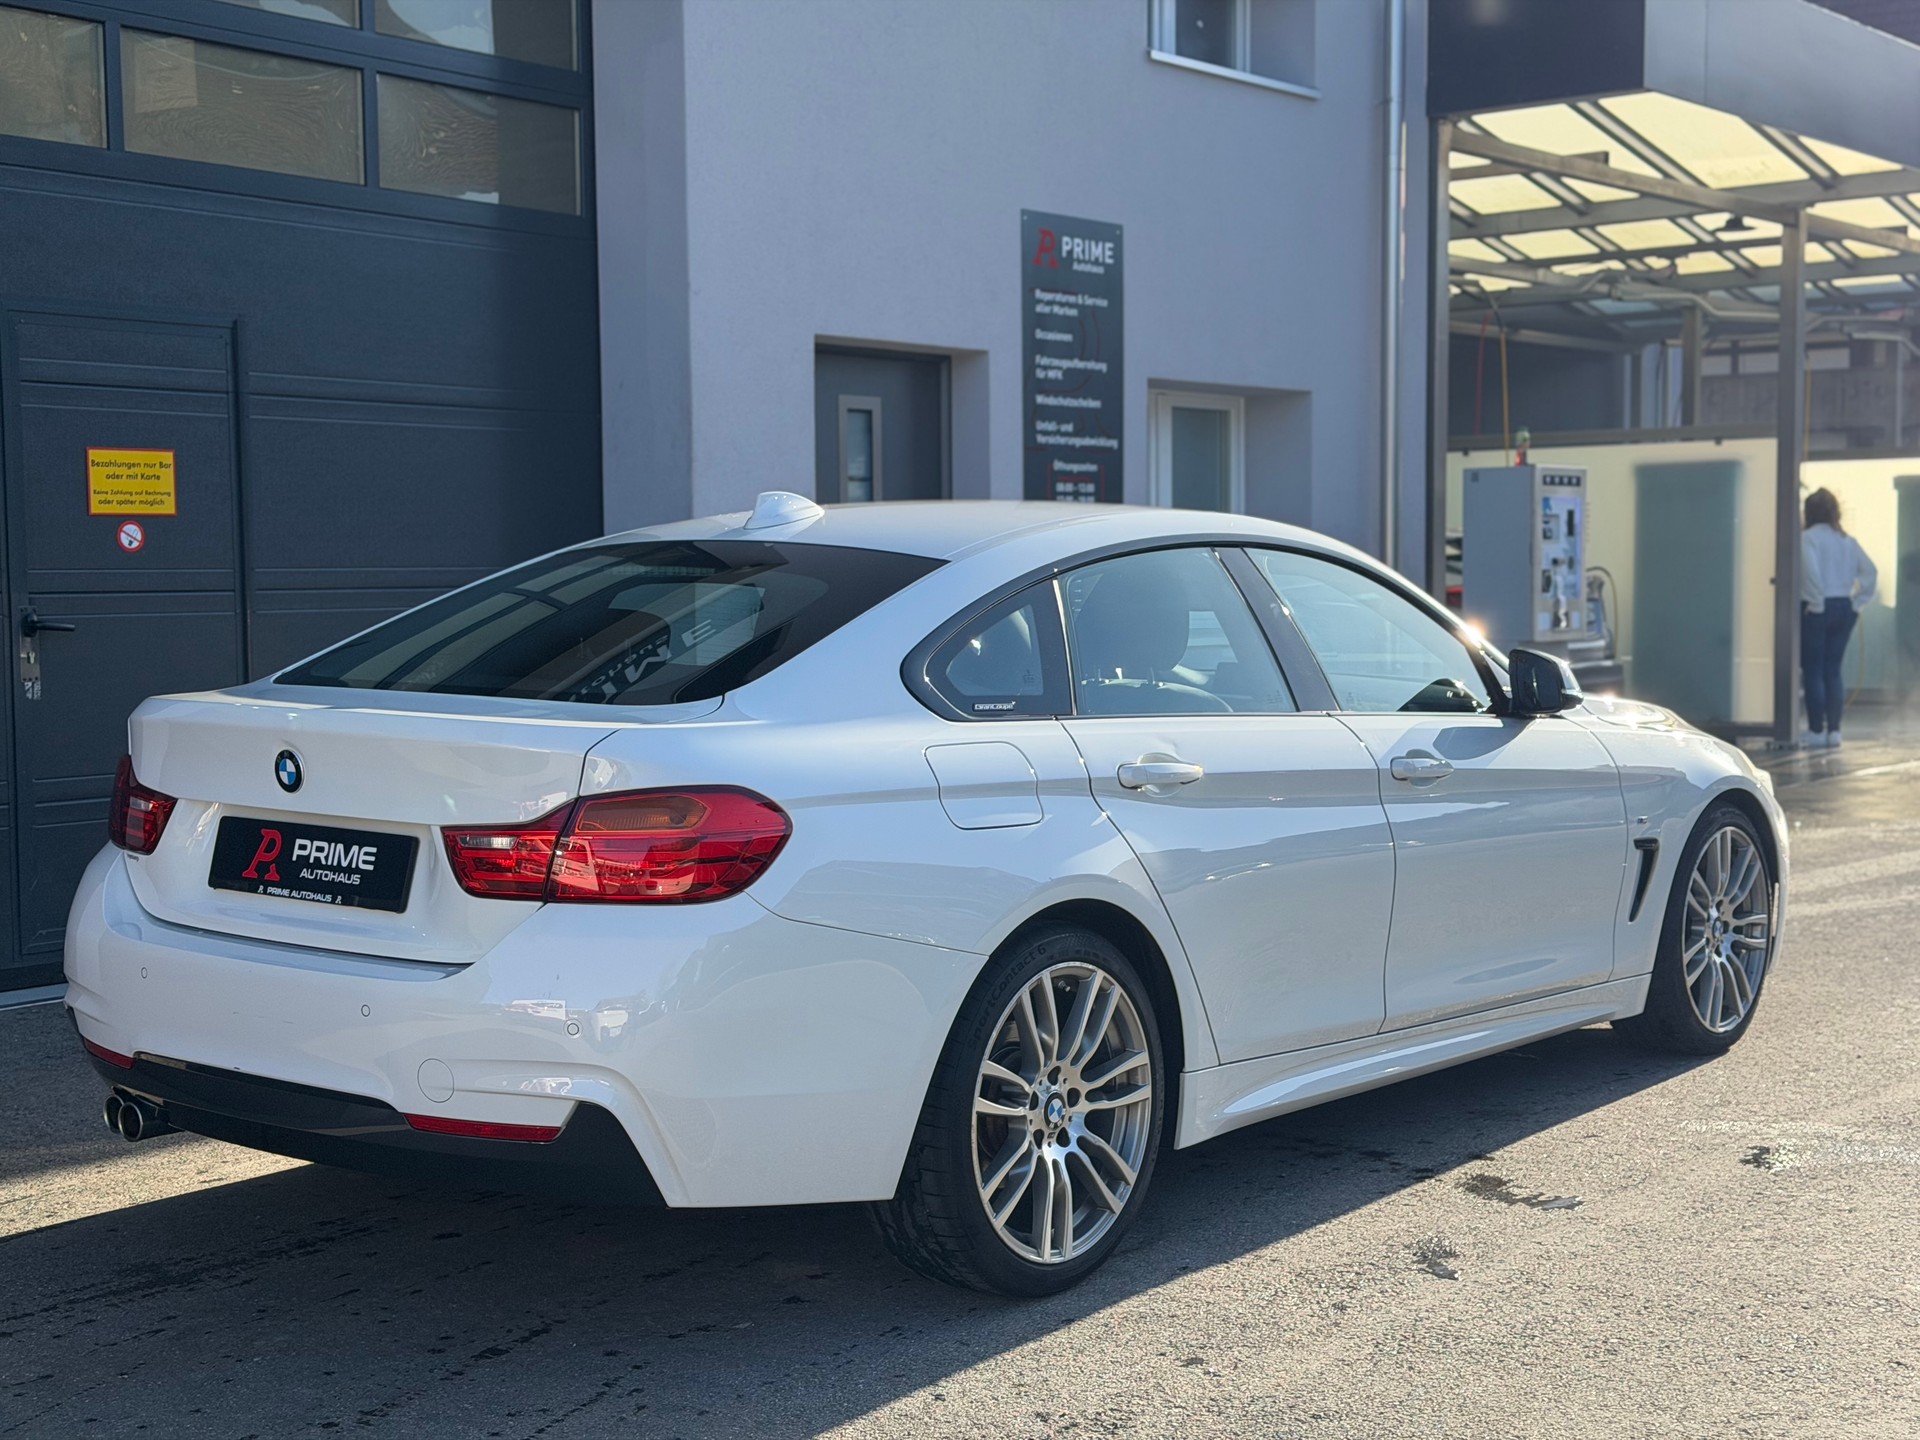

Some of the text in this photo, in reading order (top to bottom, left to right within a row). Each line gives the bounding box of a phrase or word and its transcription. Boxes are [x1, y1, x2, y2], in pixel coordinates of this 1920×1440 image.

[1061, 236, 1114, 264] PRIME
[1072, 261, 1104, 274] Autohaus
[1035, 288, 1077, 304] Reparaturen
[1084, 294, 1108, 307] Service
[1053, 305, 1078, 316] Marken
[91, 459, 141, 470] Bezahlungen
[159, 461, 172, 469] Bar
[105, 472, 124, 480] oder
[126, 472, 138, 480] mit
[138, 498, 165, 507] möglich
[292, 838, 377, 871] PRIME
[299, 868, 361, 885] AUTOHAUS
[267, 887, 290, 897] PRIME
[291, 890, 332, 902] AUTOHAUS
